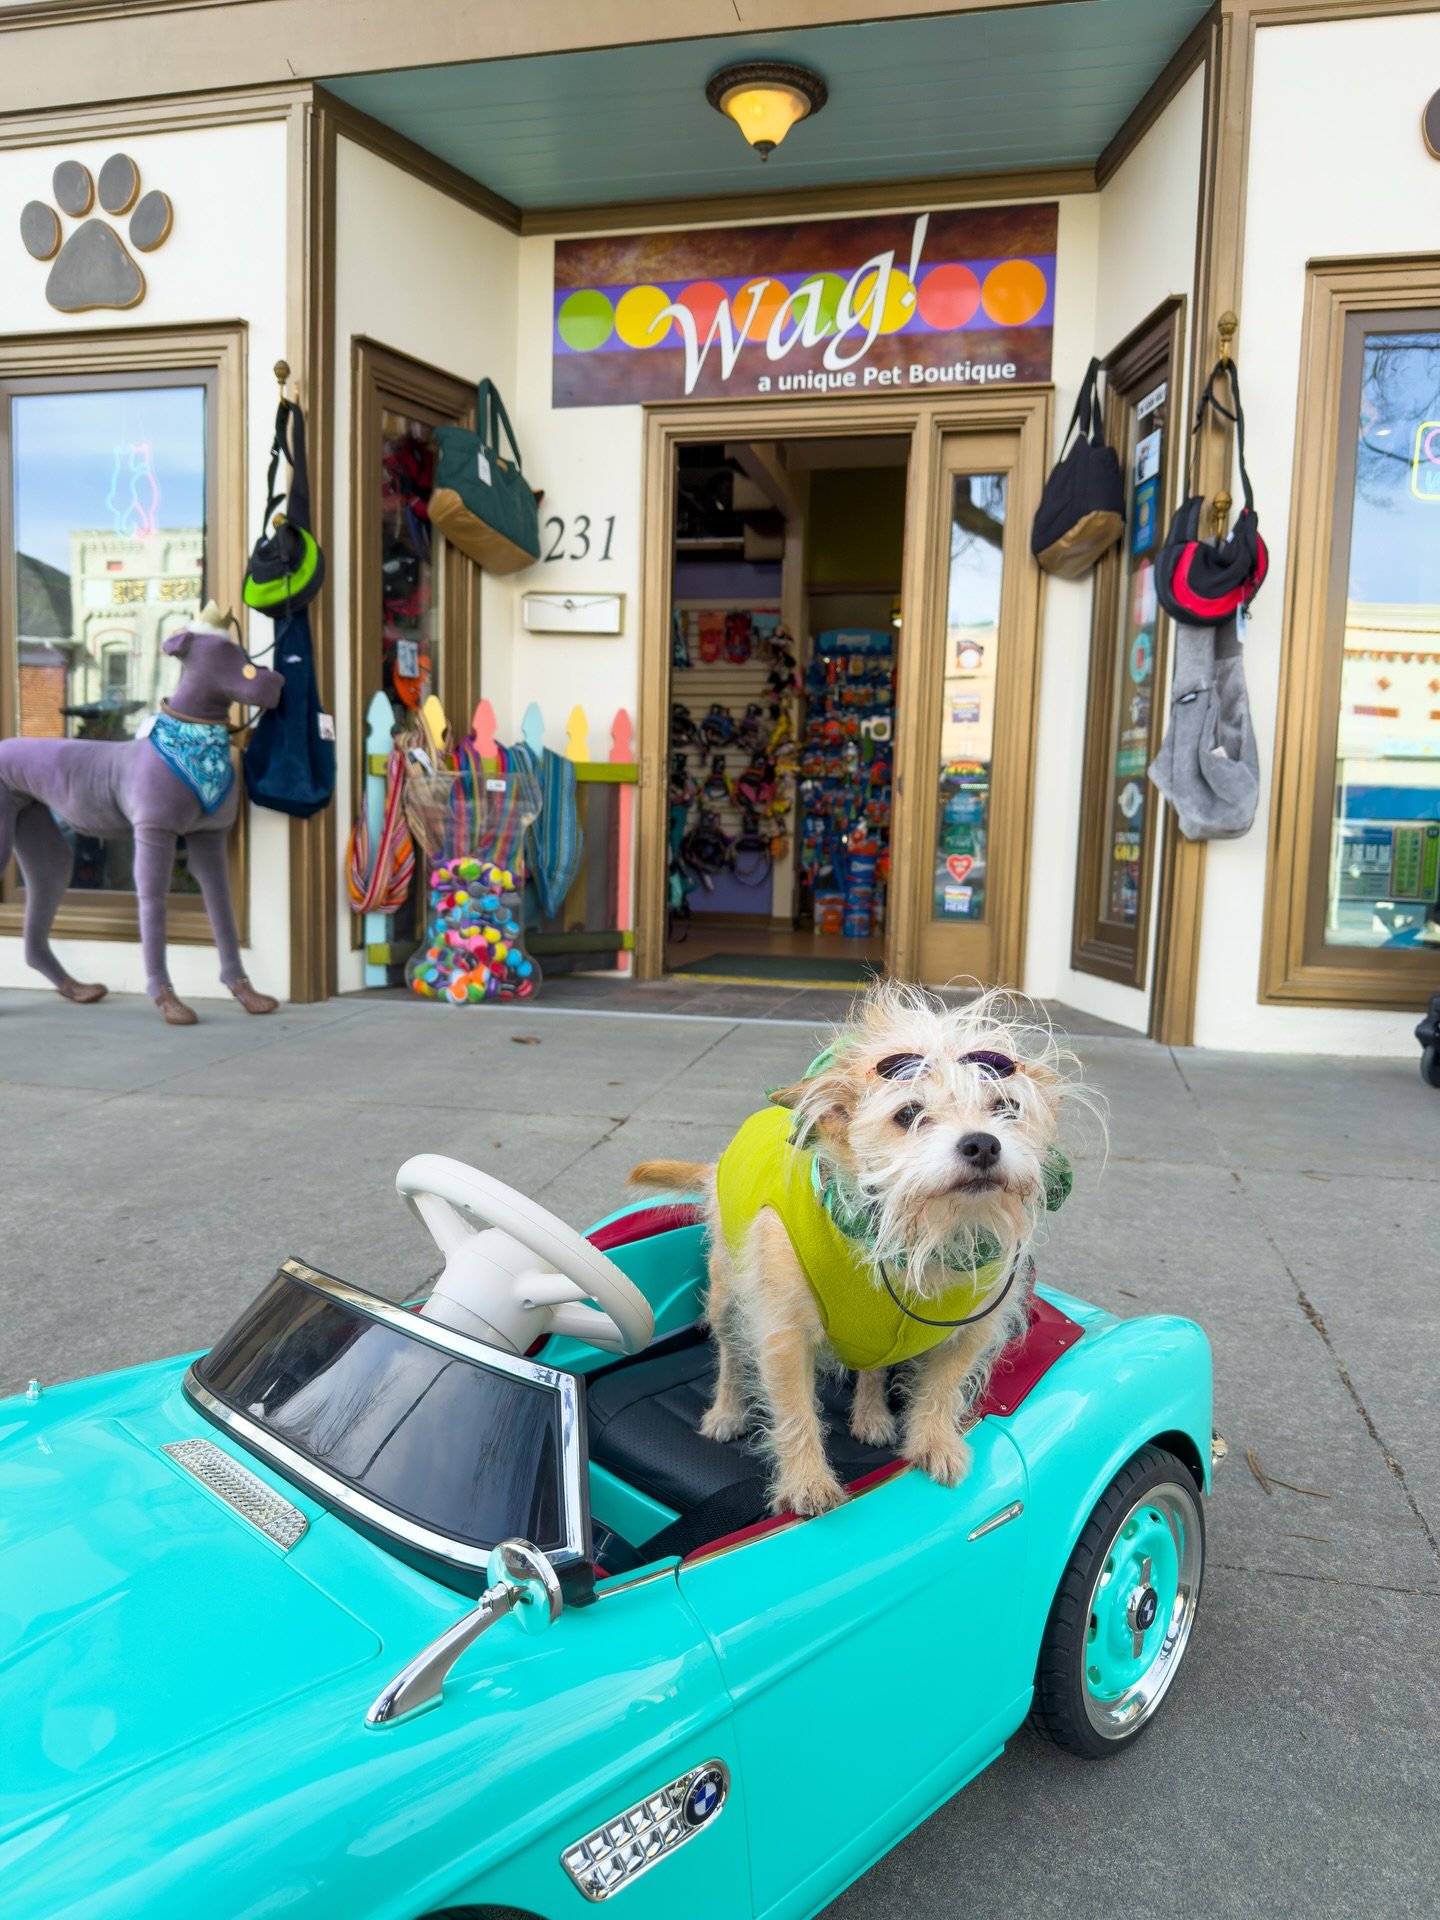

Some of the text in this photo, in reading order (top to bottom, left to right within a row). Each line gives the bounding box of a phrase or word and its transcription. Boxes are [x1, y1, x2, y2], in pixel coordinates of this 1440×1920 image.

[647, 213, 929, 395] Wag!
[758, 361, 1017, 393] a unique Pet Boutique
[543, 514, 616, 563] 231
[691, 1772, 721, 1799] BMW
